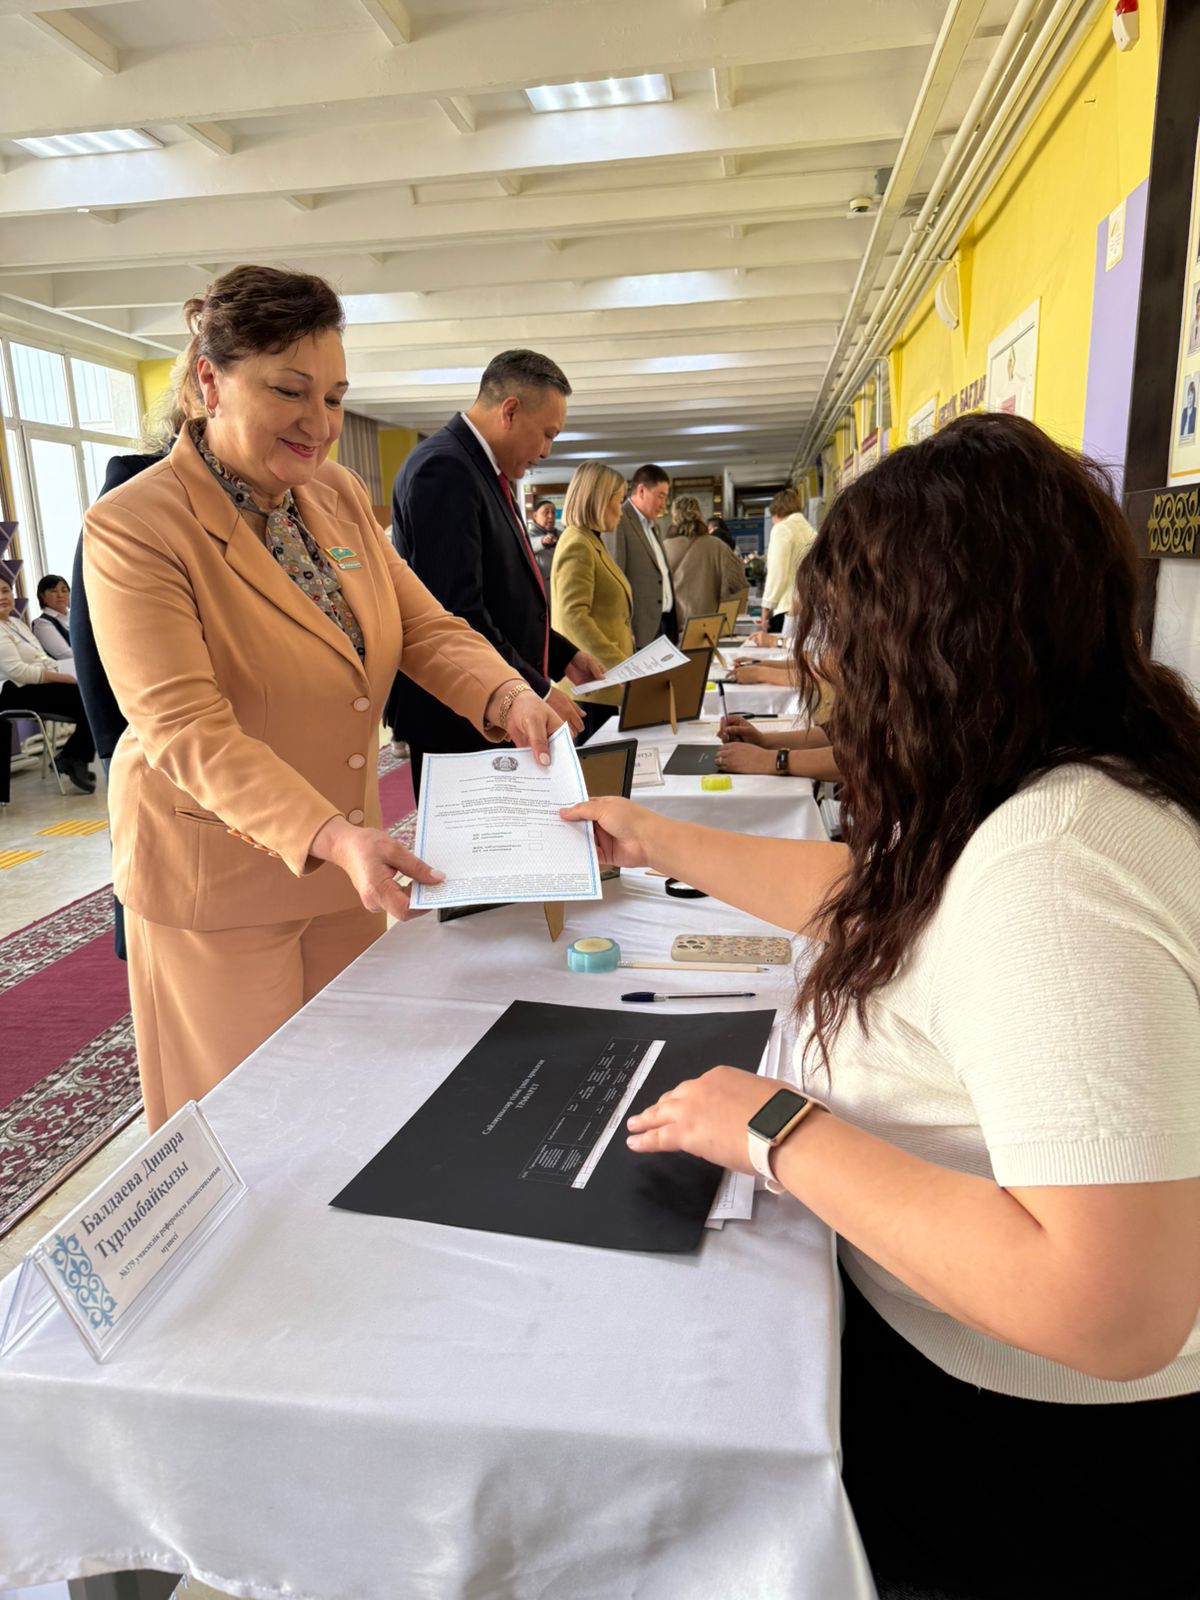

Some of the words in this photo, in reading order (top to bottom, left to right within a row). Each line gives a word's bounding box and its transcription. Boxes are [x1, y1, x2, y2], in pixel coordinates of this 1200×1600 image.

[80, 1172, 143, 1236] Балдаева
[141, 1131, 184, 1180] Динара
[159, 1203, 188, 1238] референдум
